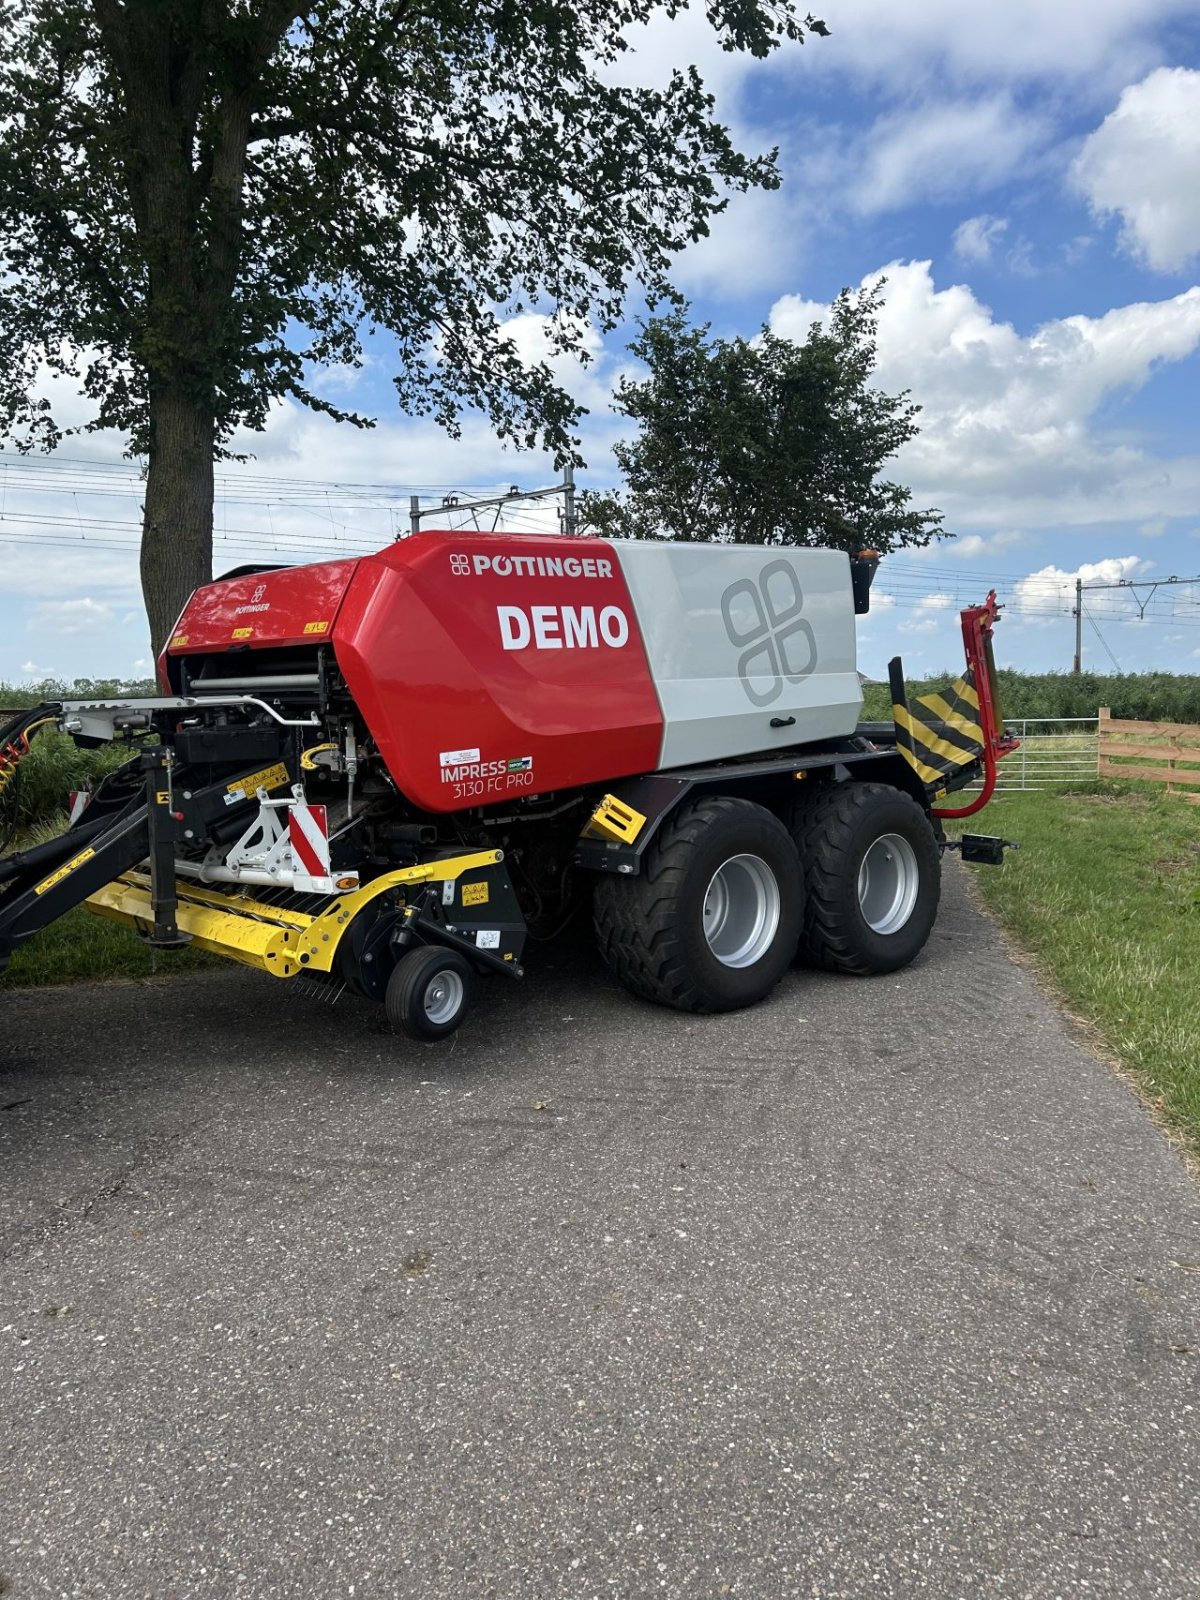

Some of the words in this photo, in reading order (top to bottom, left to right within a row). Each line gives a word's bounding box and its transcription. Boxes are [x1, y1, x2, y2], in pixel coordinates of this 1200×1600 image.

[496, 605, 629, 650] DEMO
[440, 760, 506, 783] IMPRESS
[453, 780, 484, 799] 3130
[487, 777, 503, 792] FC
[506, 771, 534, 789] PRO
